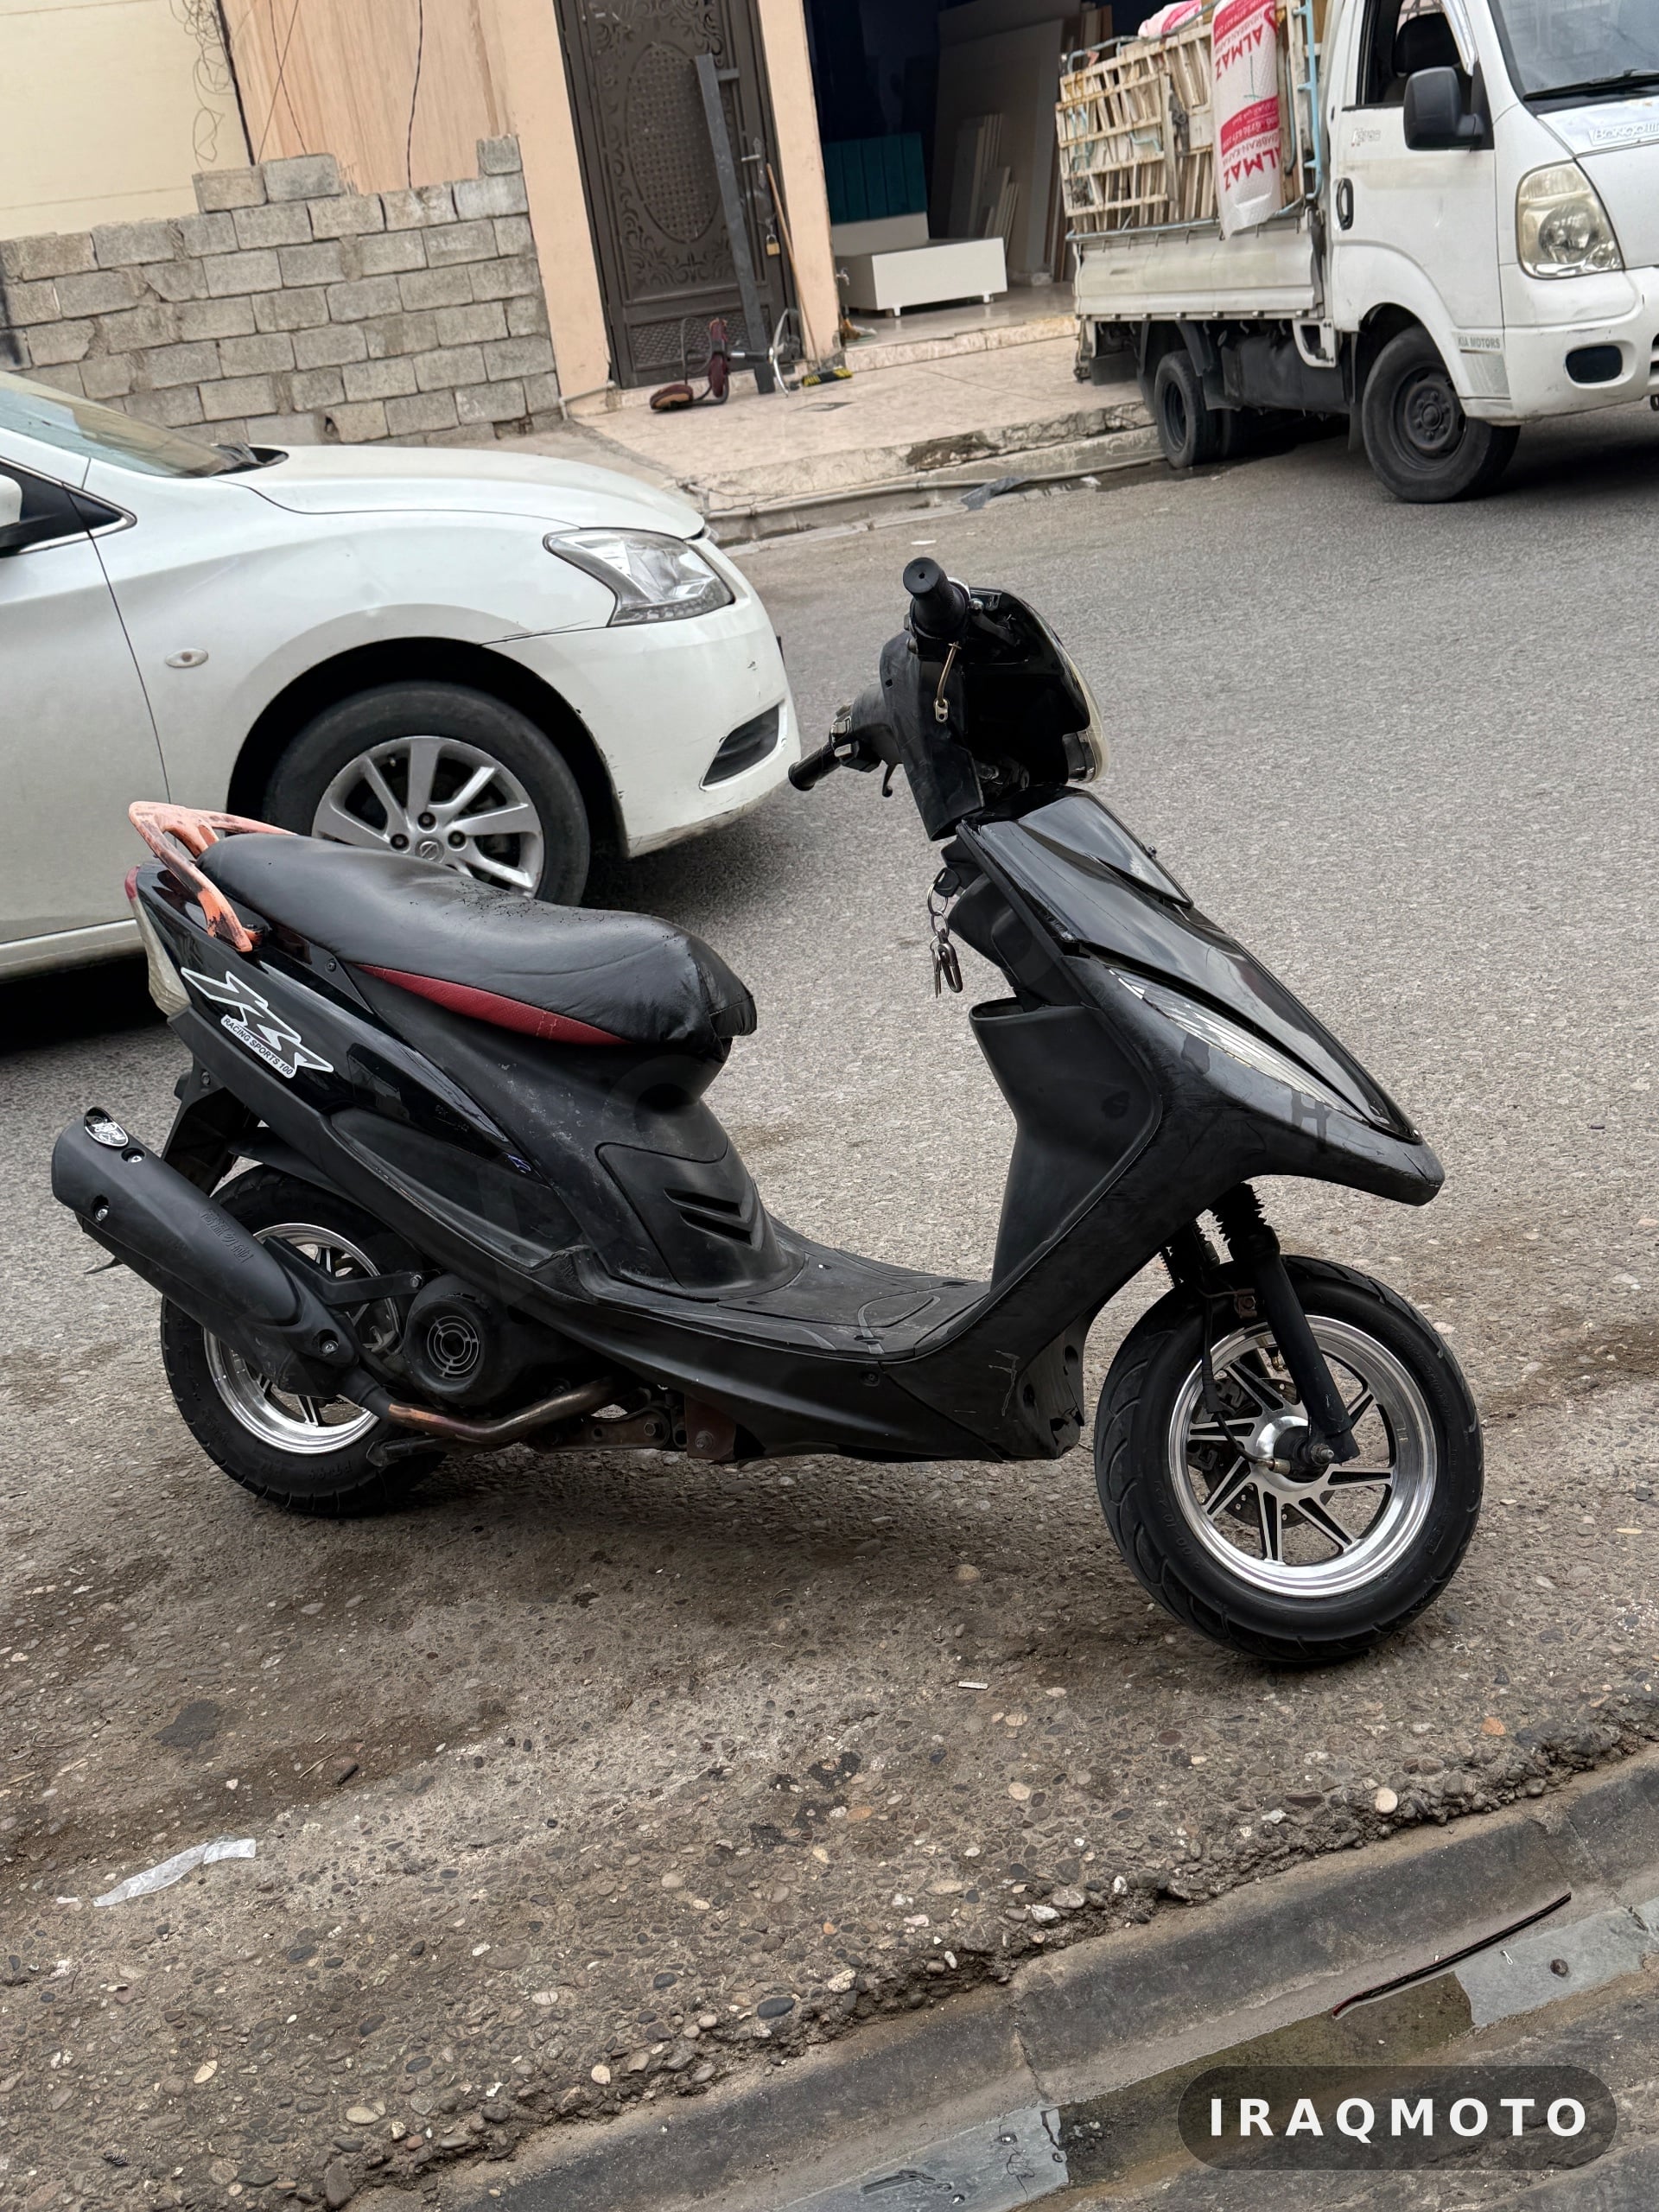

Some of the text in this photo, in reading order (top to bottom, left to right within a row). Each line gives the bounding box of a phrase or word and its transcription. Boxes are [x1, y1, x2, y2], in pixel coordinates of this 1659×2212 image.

[1215, 23, 1263, 80] ALMAZ
[223, 1017, 294, 1076] RACING SPORTS 100
